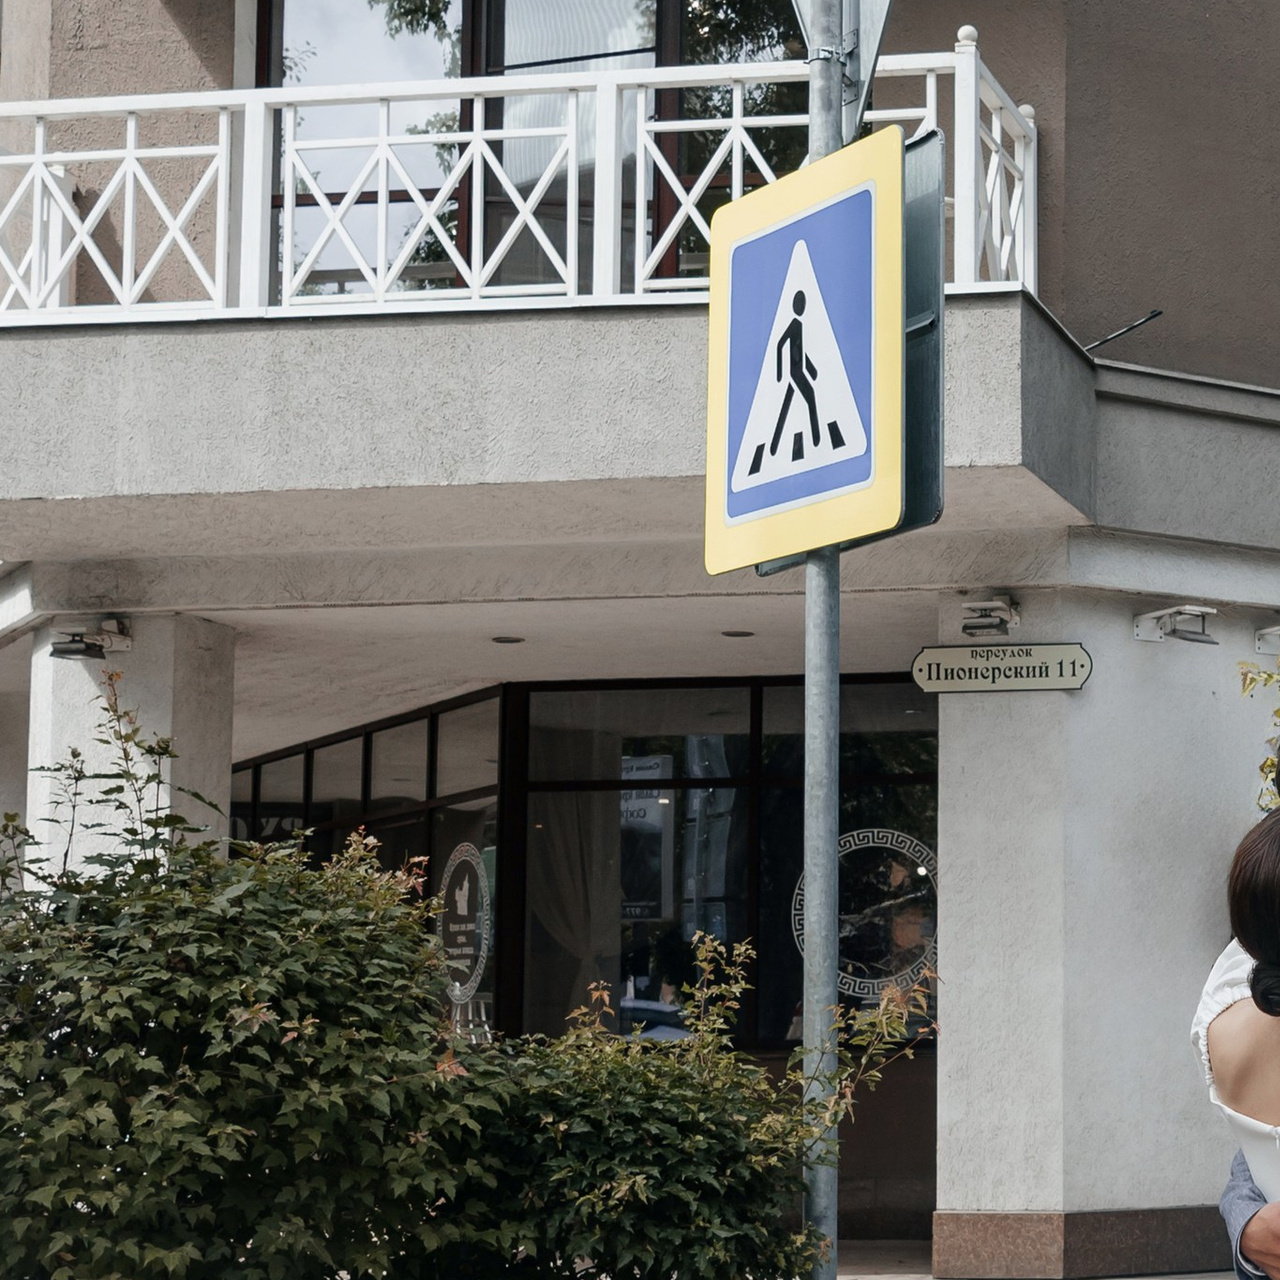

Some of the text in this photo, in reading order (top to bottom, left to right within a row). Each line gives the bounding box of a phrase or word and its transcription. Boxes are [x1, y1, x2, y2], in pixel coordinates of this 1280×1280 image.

[970, 648, 1033, 661] переулок
[926, 658, 1078, 684] Пионерский 11
